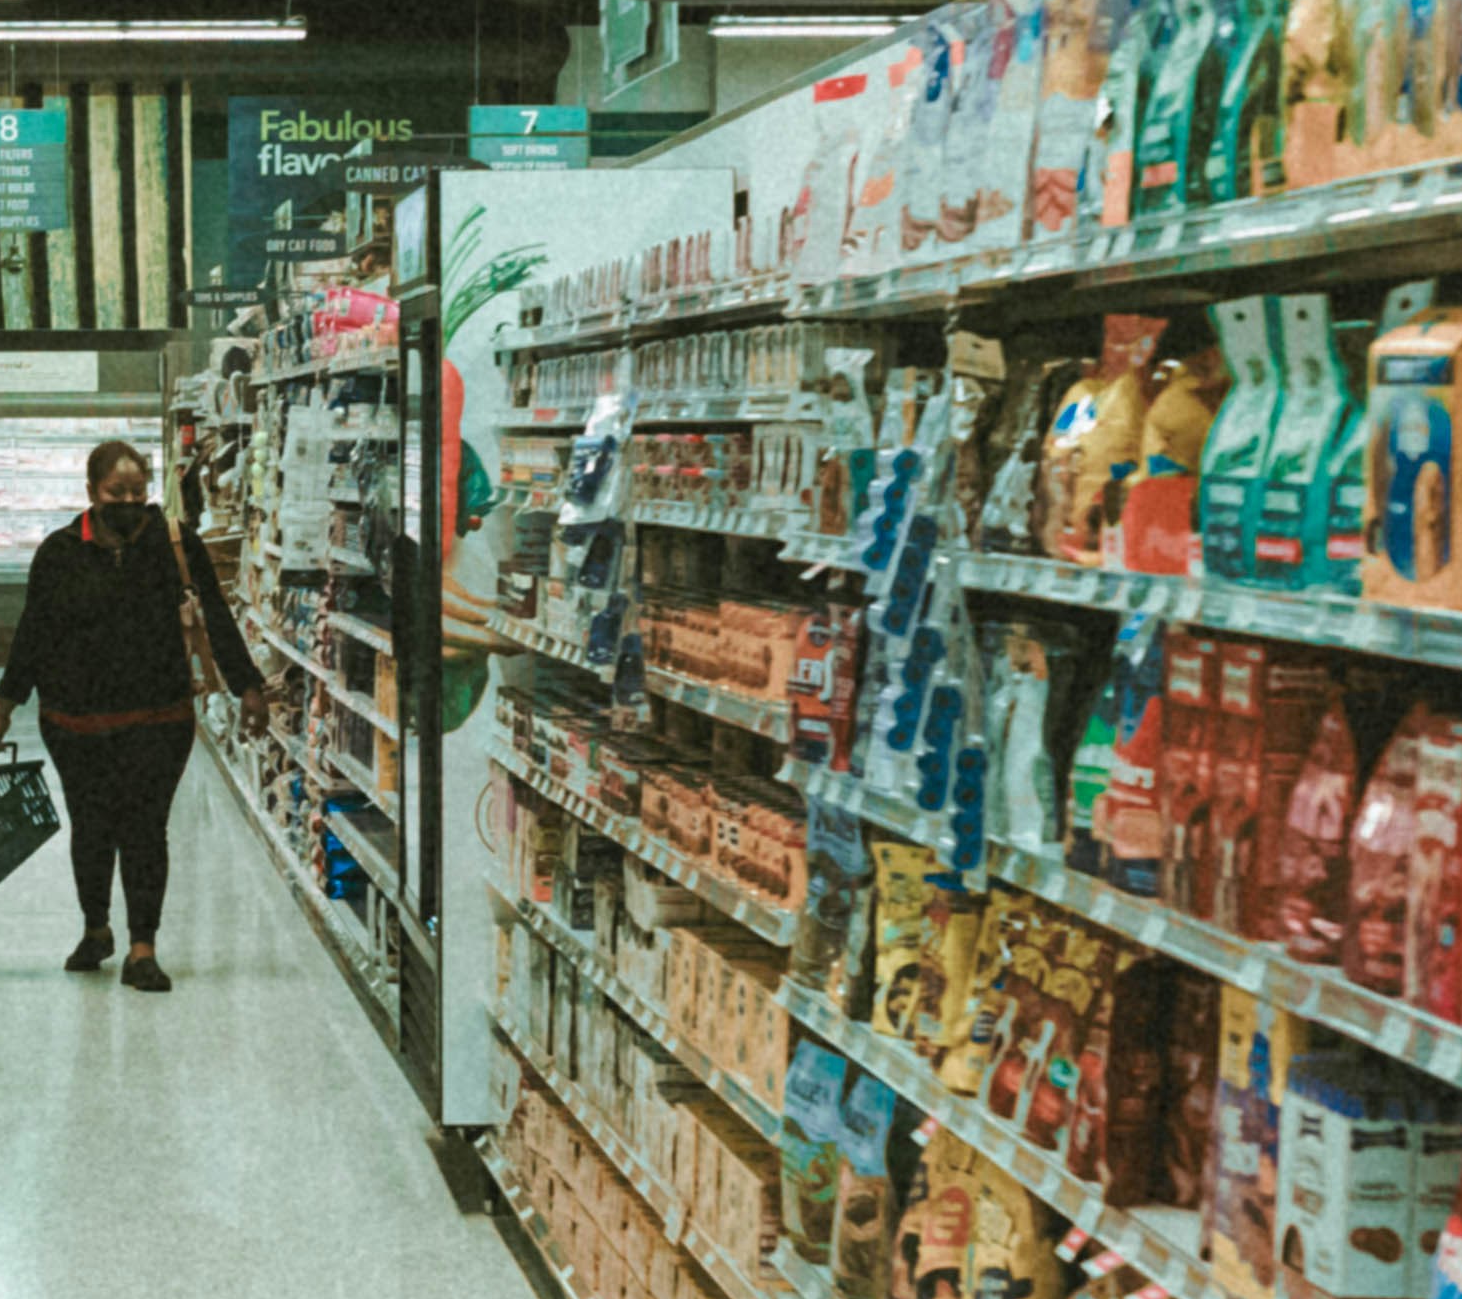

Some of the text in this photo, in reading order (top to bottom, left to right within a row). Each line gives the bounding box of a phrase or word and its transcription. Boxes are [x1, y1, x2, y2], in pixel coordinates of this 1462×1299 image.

[0, 114, 19, 142] 8
[260, 110, 413, 142] Fabulous
[519, 110, 540, 135] 7
[0, 148, 33, 160] FILTERS
[345, 166, 399, 183] CANNED
[7, 199, 29, 210] FOOD
[0, 216, 40, 228] SUPPLIES
[288, 239, 306, 252] CAT
[309, 239, 337, 252] FOOD
